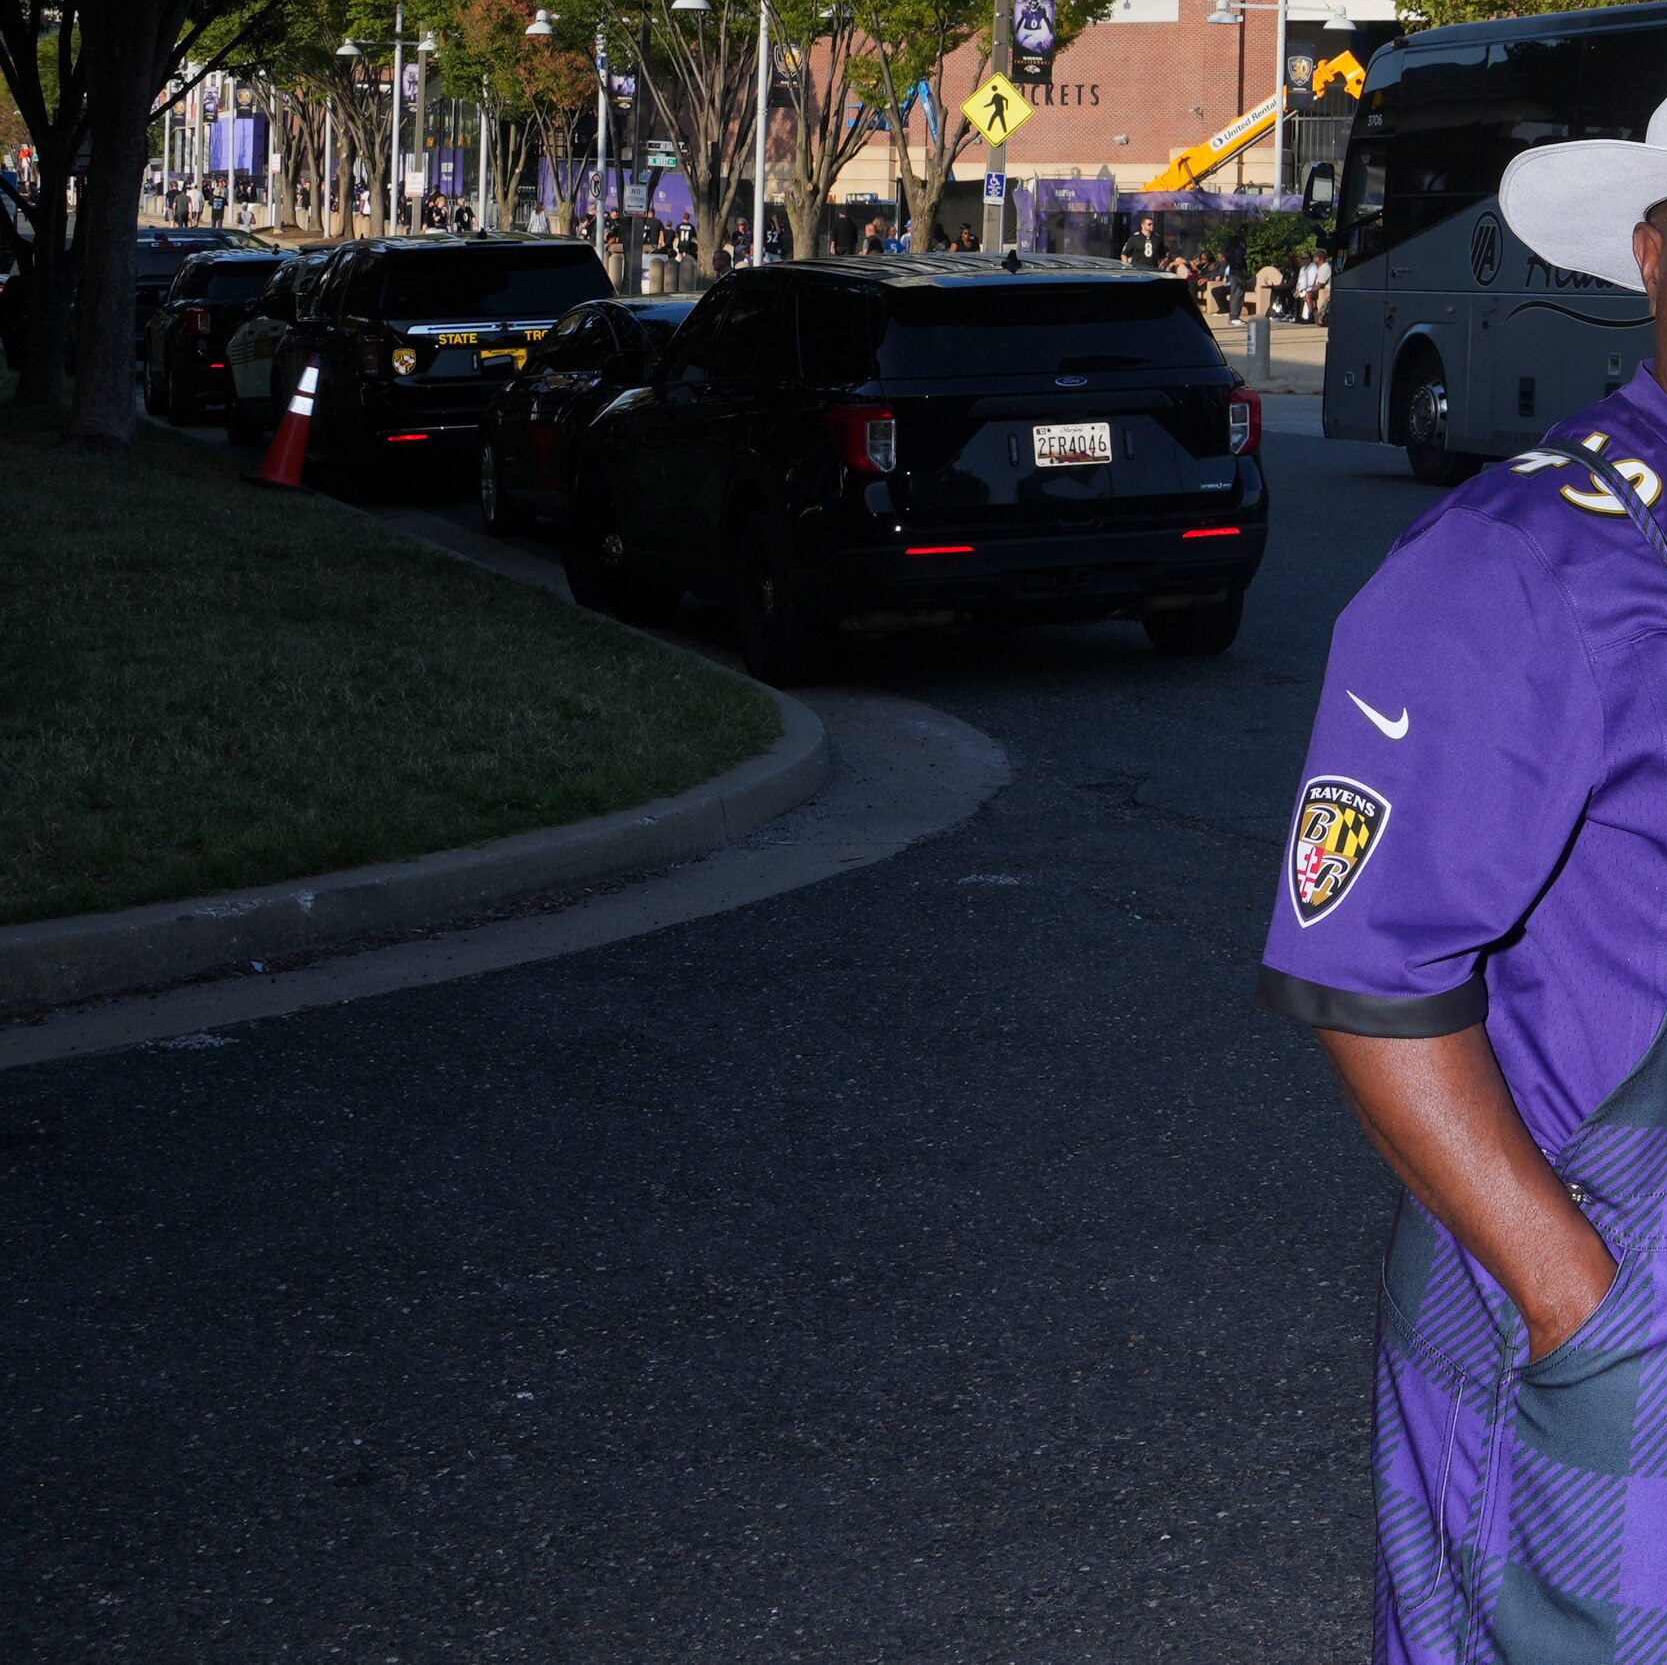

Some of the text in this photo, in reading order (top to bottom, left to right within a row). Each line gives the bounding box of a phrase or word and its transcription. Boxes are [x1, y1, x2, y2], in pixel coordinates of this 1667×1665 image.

[1020, 84, 1099, 106] ICKETS
[1223, 99, 1277, 141] United Rental
[1367, 114, 1383, 127] 3706
[766, 231, 779, 243] 52
[1144, 242, 1153, 258] 8
[438, 333, 478, 345] STATE
[1038, 434, 1107, 457] 2FR4046
[1310, 786, 1376, 817] RAVENS
